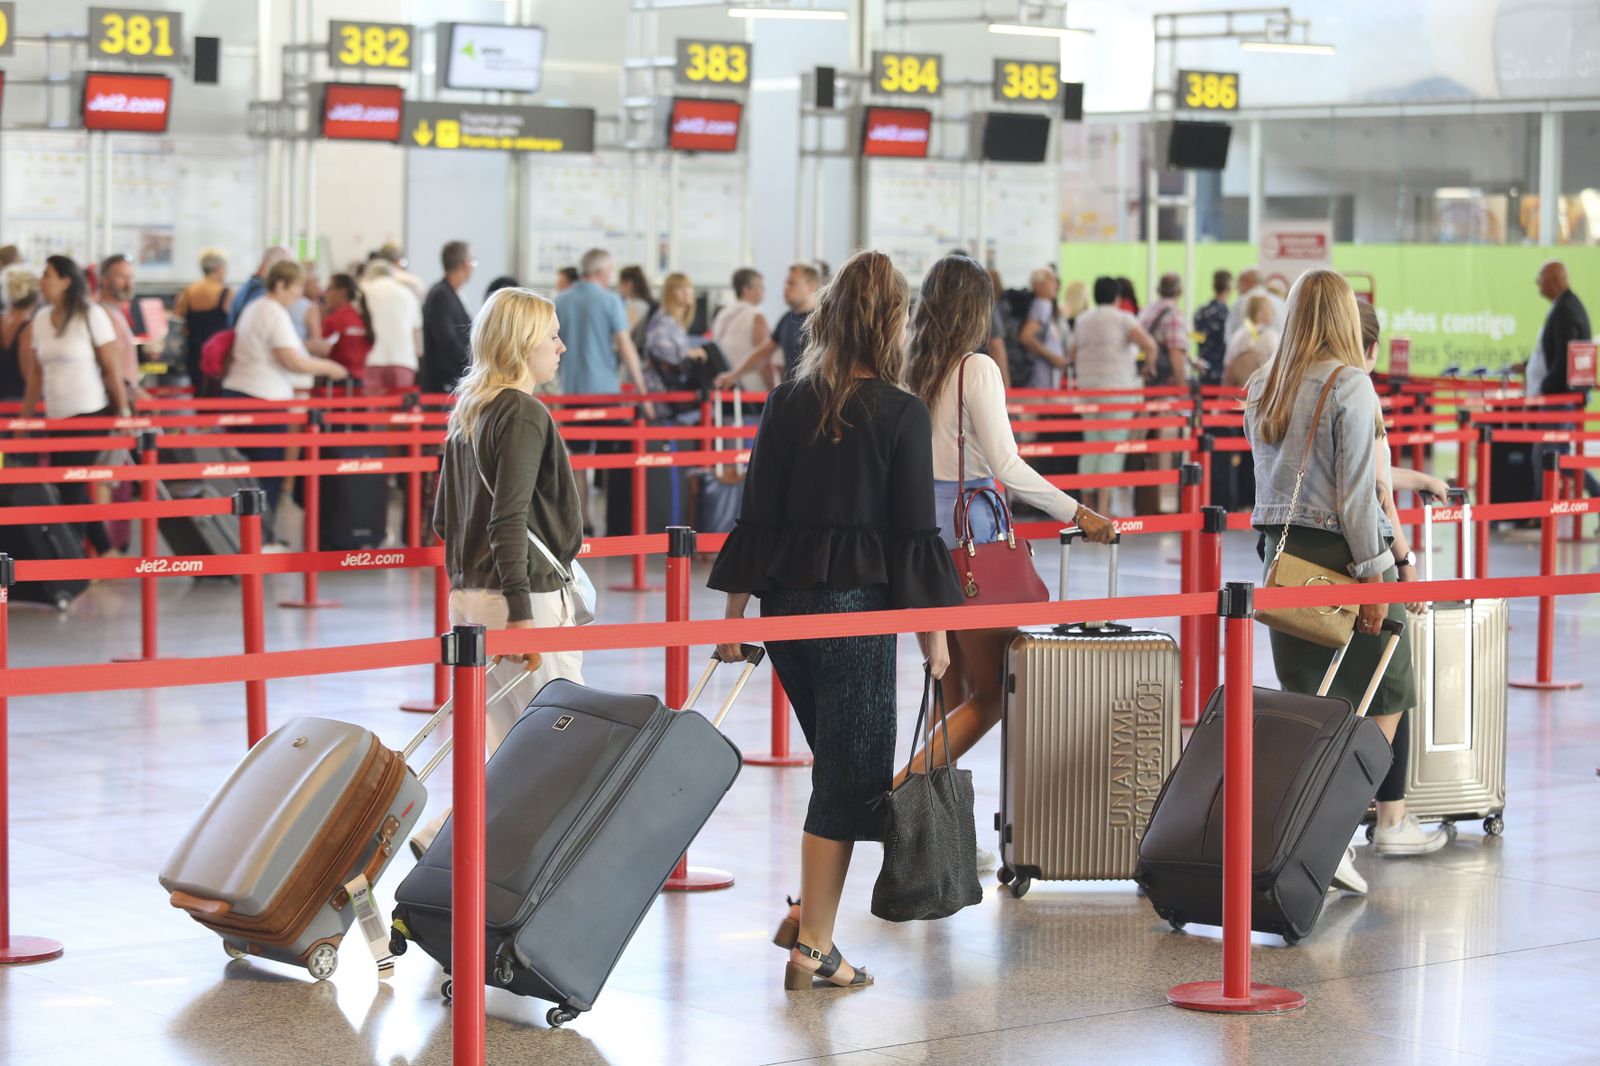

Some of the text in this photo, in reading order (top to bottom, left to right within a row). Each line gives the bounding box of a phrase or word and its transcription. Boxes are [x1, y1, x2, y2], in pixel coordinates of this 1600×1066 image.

[100, 13, 174, 57] 381
[339, 25, 410, 68] 382
[685, 43, 748, 84] 383
[880, 54, 940, 94] 384
[1001, 63, 1059, 100] 385
[87, 92, 166, 113] Jet2.com
[1186, 72, 1237, 110] 386
[1441, 309, 1516, 340] contigo
[1550, 501, 1588, 514] Jet2.com
[1135, 679, 1163, 742] RECH
[1109, 699, 1134, 828] UNANYME
[353, 888, 368, 899] AGP
